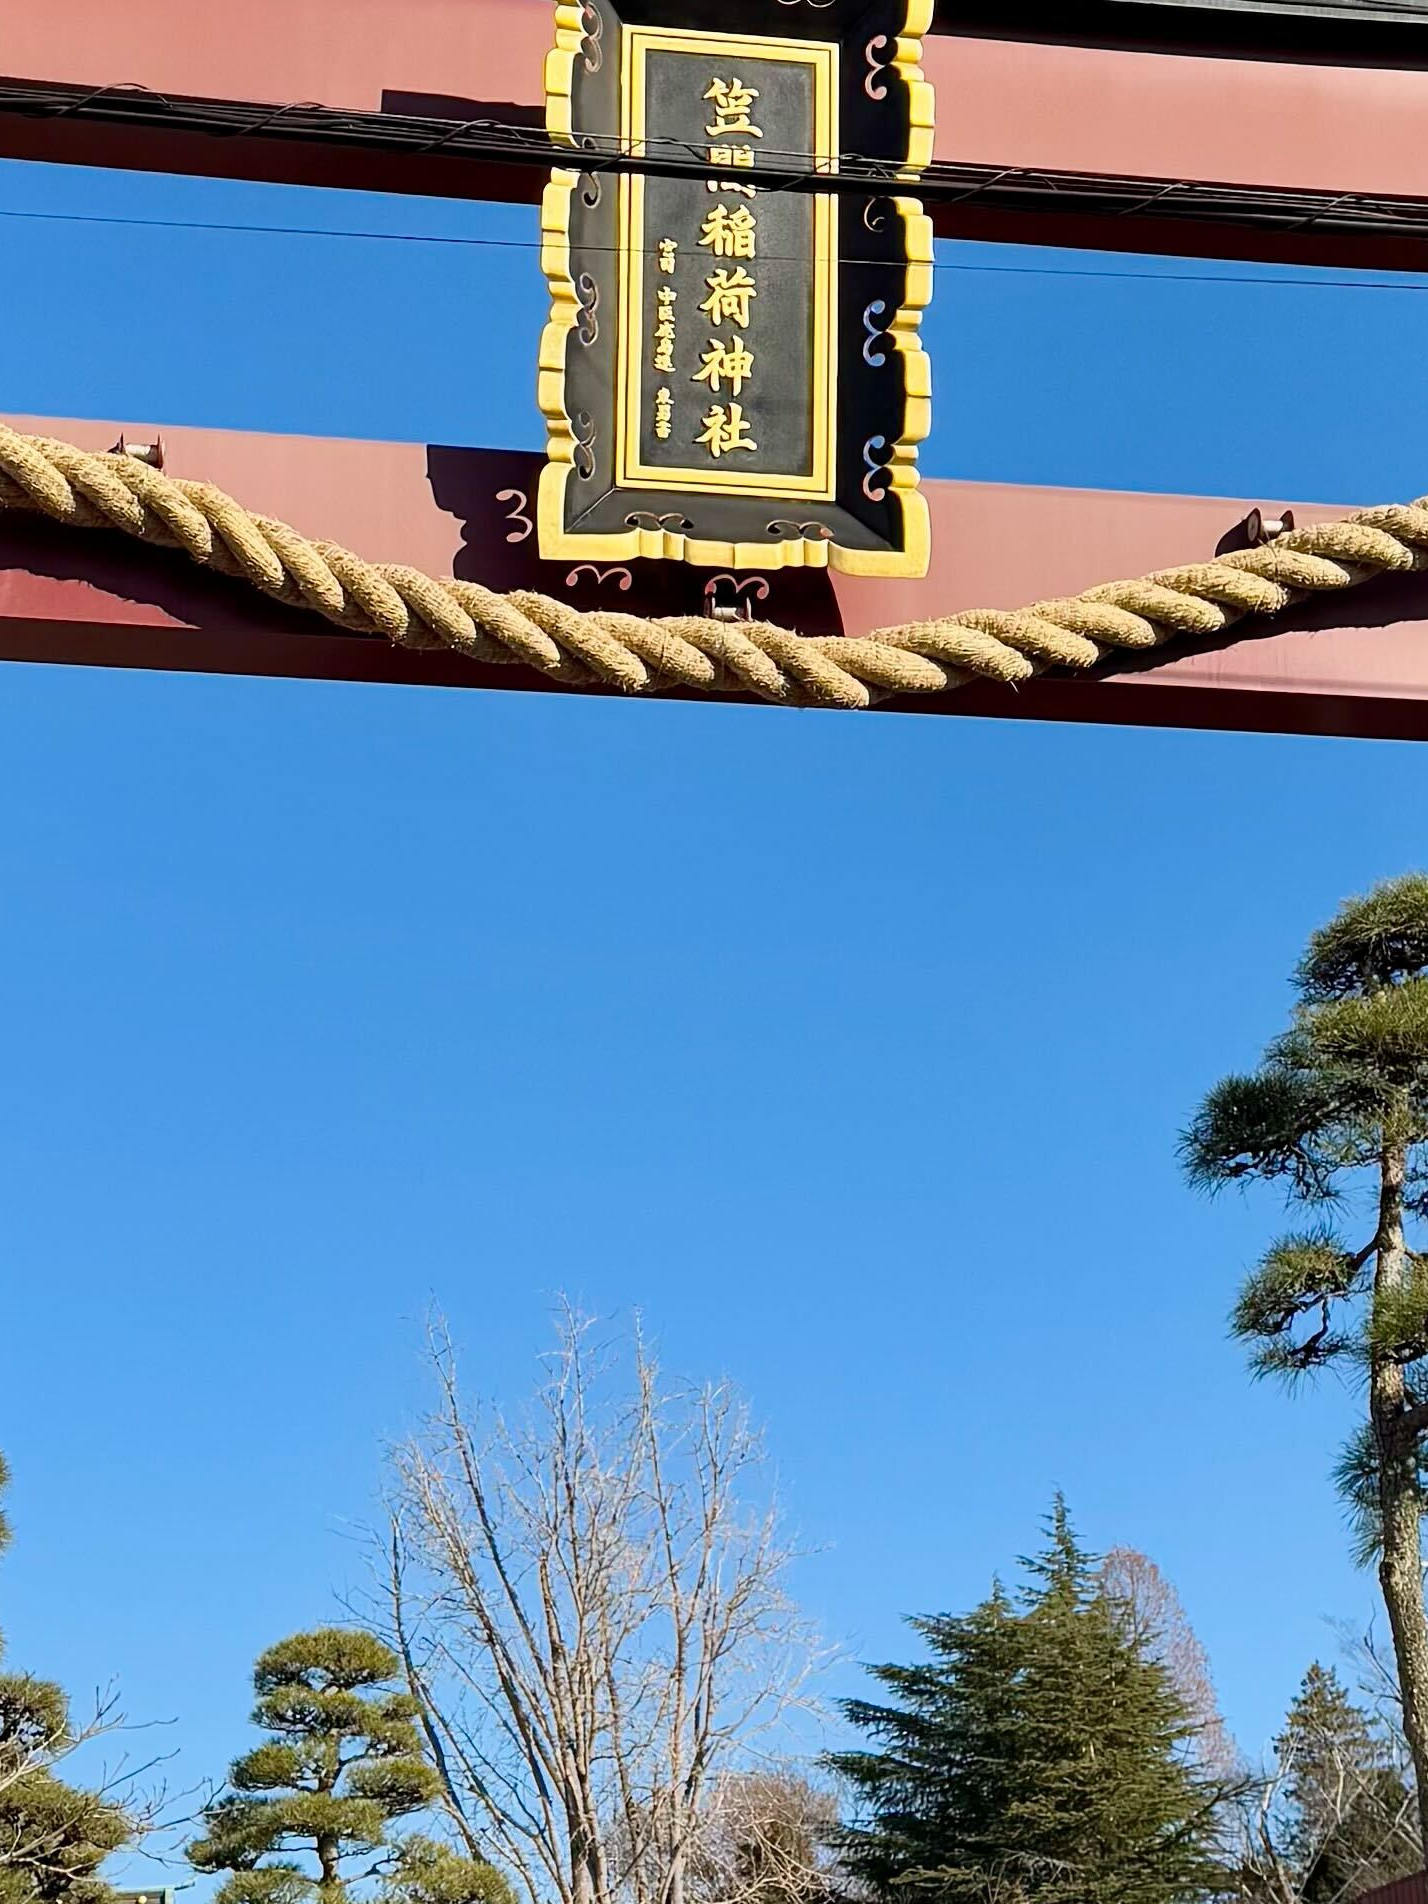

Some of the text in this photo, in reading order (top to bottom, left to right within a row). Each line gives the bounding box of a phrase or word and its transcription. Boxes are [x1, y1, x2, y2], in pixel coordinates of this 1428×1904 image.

[691, 76, 764, 459] 笠間稲荷神社
